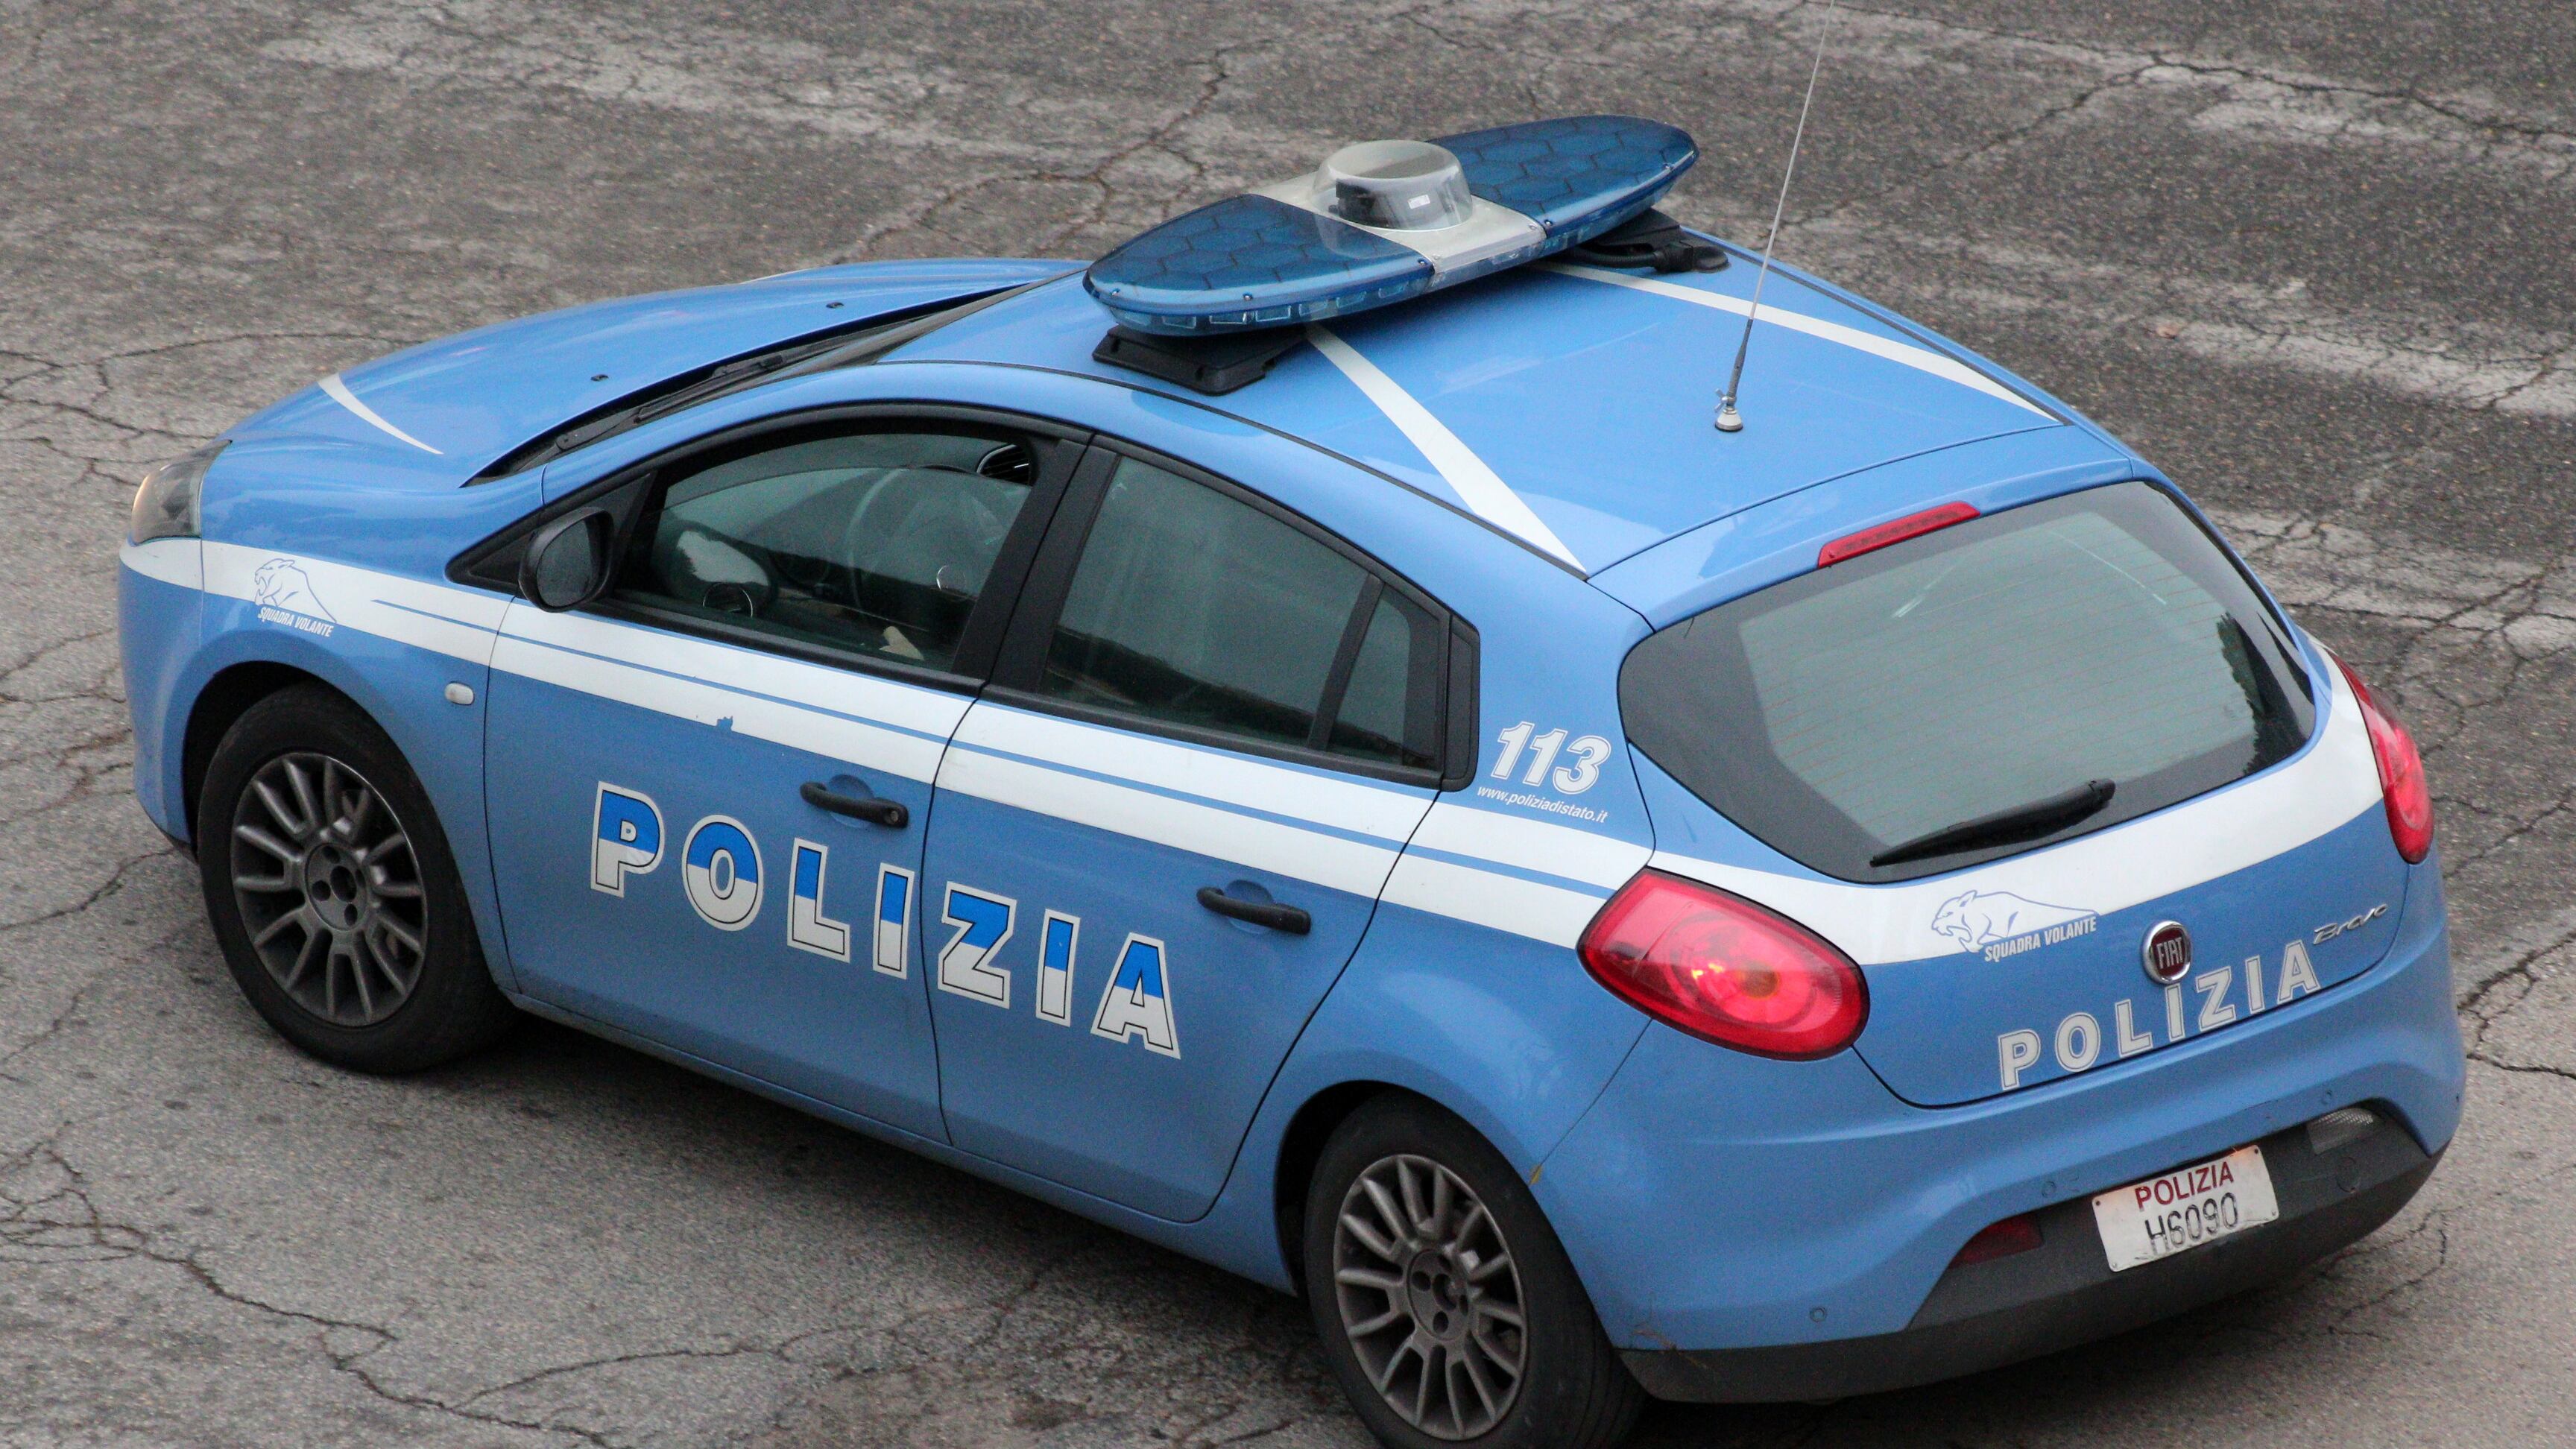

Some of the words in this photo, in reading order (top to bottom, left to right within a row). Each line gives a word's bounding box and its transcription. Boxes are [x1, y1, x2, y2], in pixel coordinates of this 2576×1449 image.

[257, 607, 295, 627] SQUADRA
[294, 616, 334, 637] VOLANTE
[1491, 721, 1611, 795] 113
[1477, 786, 1609, 823] www.poliziadistato.it
[590, 780, 1181, 1059] POLIZIA
[1984, 933, 2042, 962] SQUADRA
[2044, 916, 2097, 946] VOLANTE
[2156, 937, 2184, 969] FIAT
[1998, 939, 2321, 1090] POLIZIA
[2134, 1161, 2235, 1211] POLIZIA
[2144, 1192, 2238, 1255] H6090
